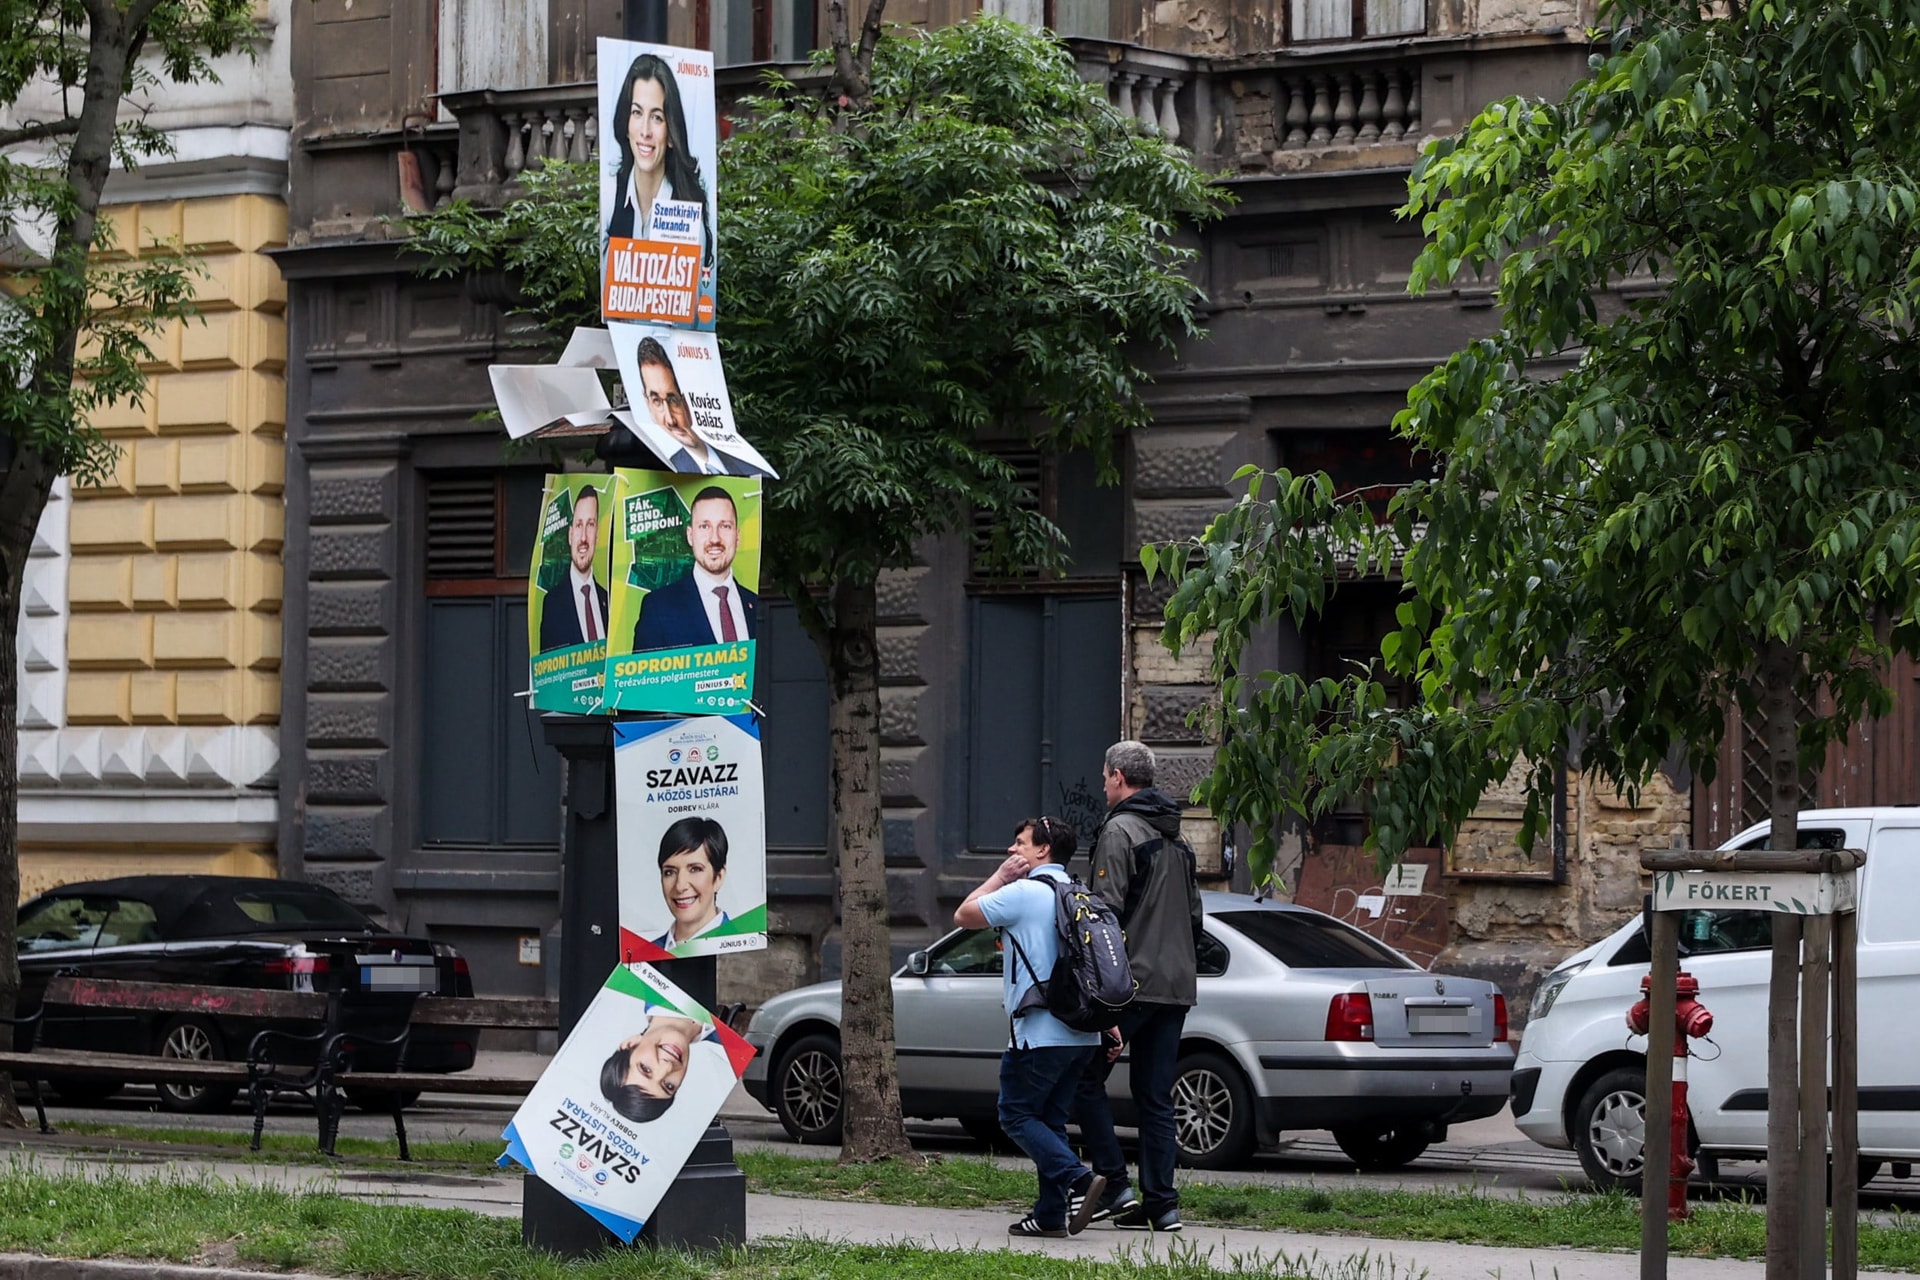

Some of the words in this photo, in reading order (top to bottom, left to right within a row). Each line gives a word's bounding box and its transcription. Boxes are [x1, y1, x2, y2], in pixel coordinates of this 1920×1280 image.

[676, 61, 702, 76] JÚNIUS
[703, 65, 710, 78] 9.
[654, 202, 701, 222] Szentkirályi
[652, 215, 690, 233] Alexandra
[613, 243, 696, 287] VÁLTOZÁST
[608, 285, 692, 317] BUDAPESTEN!
[677, 343, 703, 359] JÚNIUS
[704, 348, 712, 360] 9.
[688, 392, 721, 411] Kovács
[695, 411, 724, 429] Balázs
[629, 497, 653, 513] FÁK.
[629, 508, 664, 523] REND.
[630, 516, 683, 534] SOPRONI.
[534, 654, 569, 677] SOPRONI
[571, 643, 606, 666] TAMÁS
[614, 655, 690, 677] SOPRONI
[694, 644, 748, 667] TAMÁS
[574, 680, 590, 689] JÚNIUS
[614, 675, 660, 688] Terézváros
[661, 668, 720, 686] polgármestere
[697, 680, 722, 691] JÚNIUS
[723, 679, 732, 688] 9.
[646, 763, 738, 789] SZAVAZZ
[647, 793, 655, 803] A
[657, 788, 692, 802] KÖZÖS
[694, 785, 739, 800] LISTÁRA!
[668, 804, 697, 814] DOBREV
[698, 802, 720, 811] KLÁRA
[1687, 881, 1771, 901] FŐKERT
[719, 939, 742, 949] JÚNIUS
[648, 972, 670, 991] JÚNIUS
[561, 1097, 607, 1135] LISTÁRA!
[589, 1102, 613, 1122] KLÁRA
[612, 1118, 638, 1141] DOBREV
[549, 1108, 642, 1184] SZAVAZZ
[606, 1130, 641, 1159] KÖZÖS
[641, 1157, 650, 1166] A
